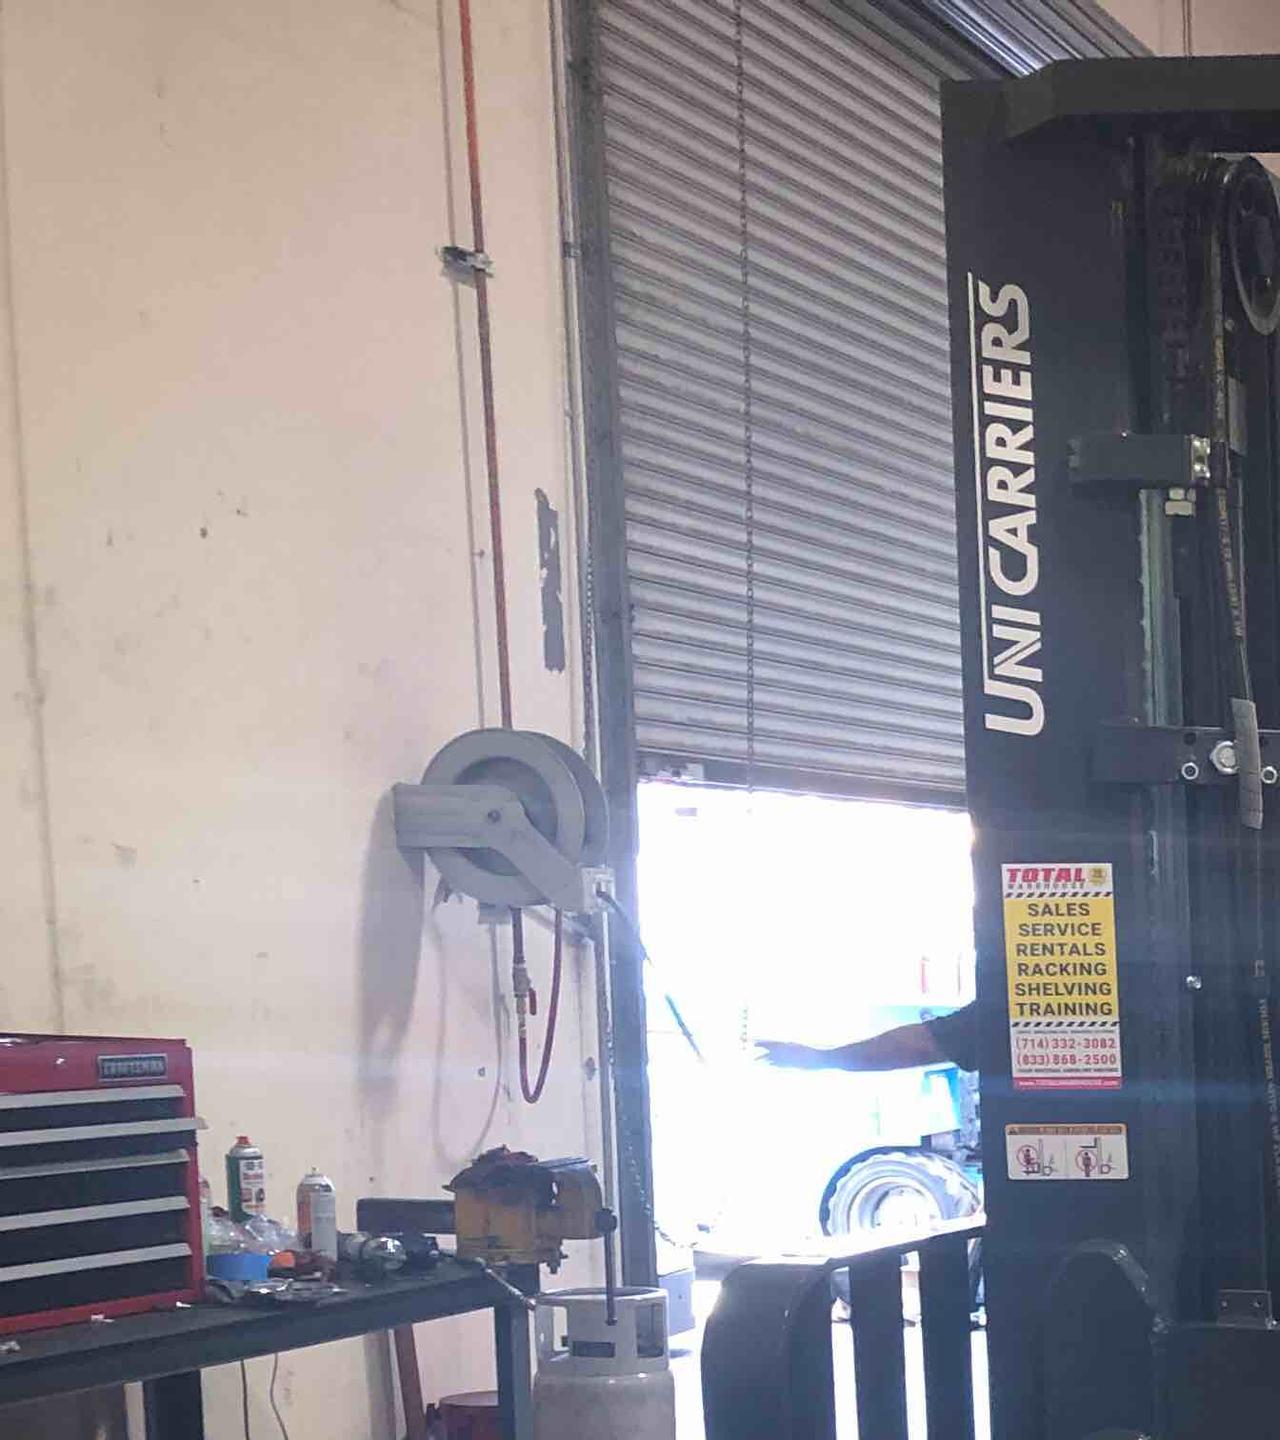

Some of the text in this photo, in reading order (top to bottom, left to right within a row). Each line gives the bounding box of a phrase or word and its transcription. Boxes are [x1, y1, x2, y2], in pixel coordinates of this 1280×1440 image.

[1006, 868, 1086, 882] TOTAL
[1027, 902, 1091, 917] SALES
[1018, 922, 1103, 937] SERVICE
[1016, 942, 1107, 957] RENTALS
[1017, 962, 1108, 977] RACKING
[1015, 982, 1113, 997] SHELVING
[1015, 1002, 1113, 1017] TRAINING
